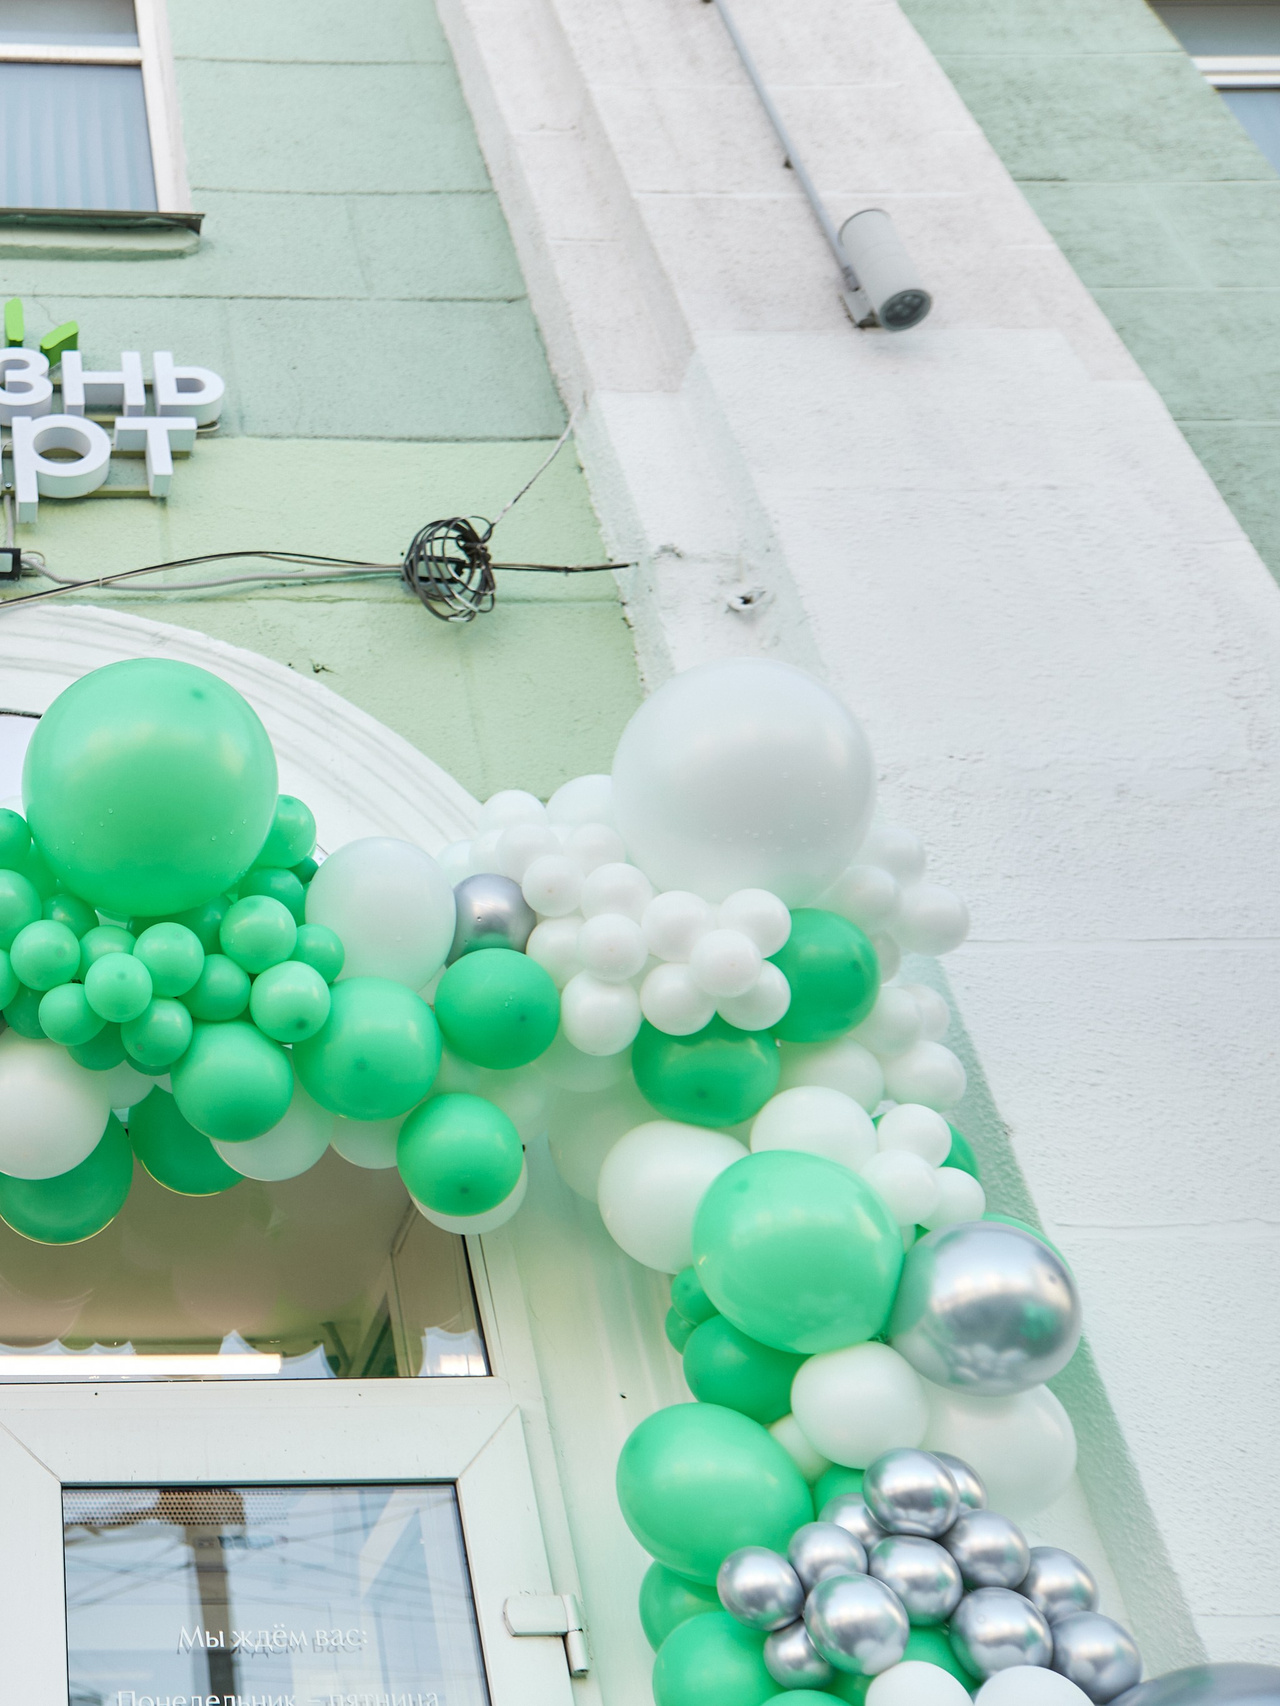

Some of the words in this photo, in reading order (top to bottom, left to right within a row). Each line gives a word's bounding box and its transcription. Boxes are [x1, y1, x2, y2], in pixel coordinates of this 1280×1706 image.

[179, 1625, 225, 1648] Мы
[232, 1623, 308, 1652] ждём
[315, 1627, 368, 1647] вас:
